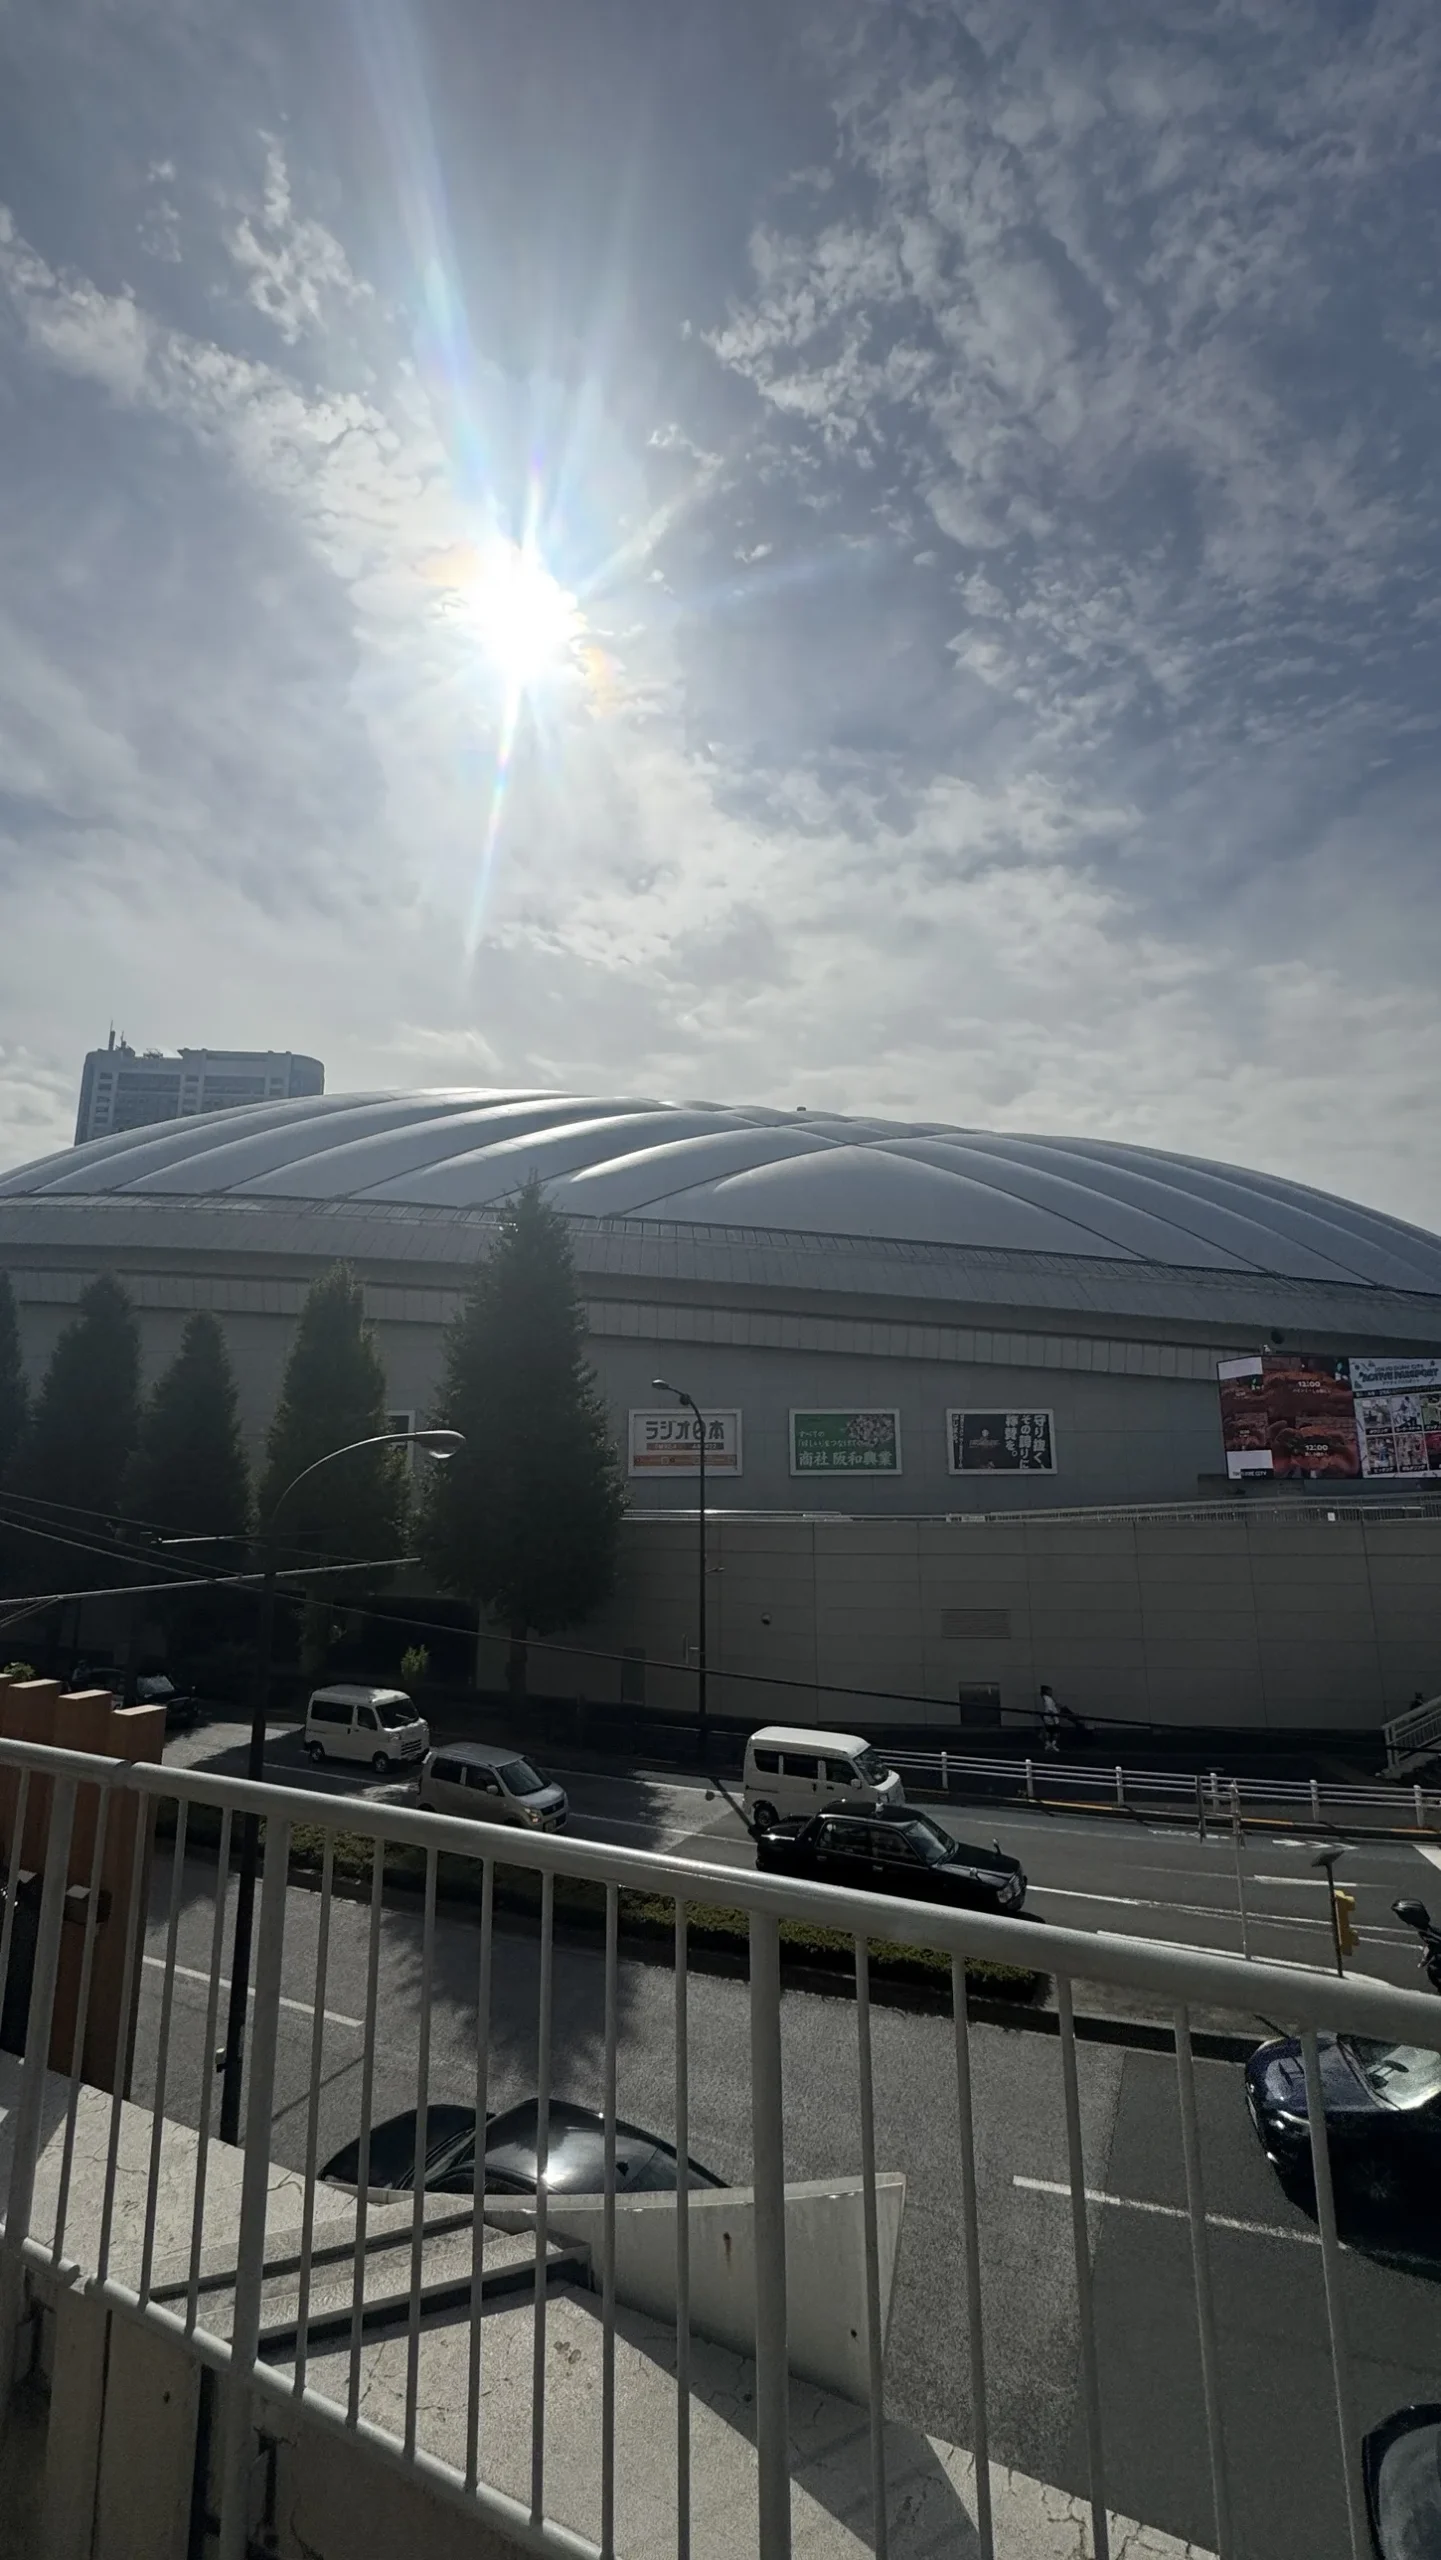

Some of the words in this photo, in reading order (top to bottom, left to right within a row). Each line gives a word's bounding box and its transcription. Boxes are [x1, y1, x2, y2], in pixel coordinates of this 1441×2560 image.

[646, 1420, 724, 1440] ラジオ日本
[1019, 1414, 1032, 1469] その誇りに
[799, 1450, 830, 1467] 商社
[832, 1450, 893, 1466] 阪和興業
